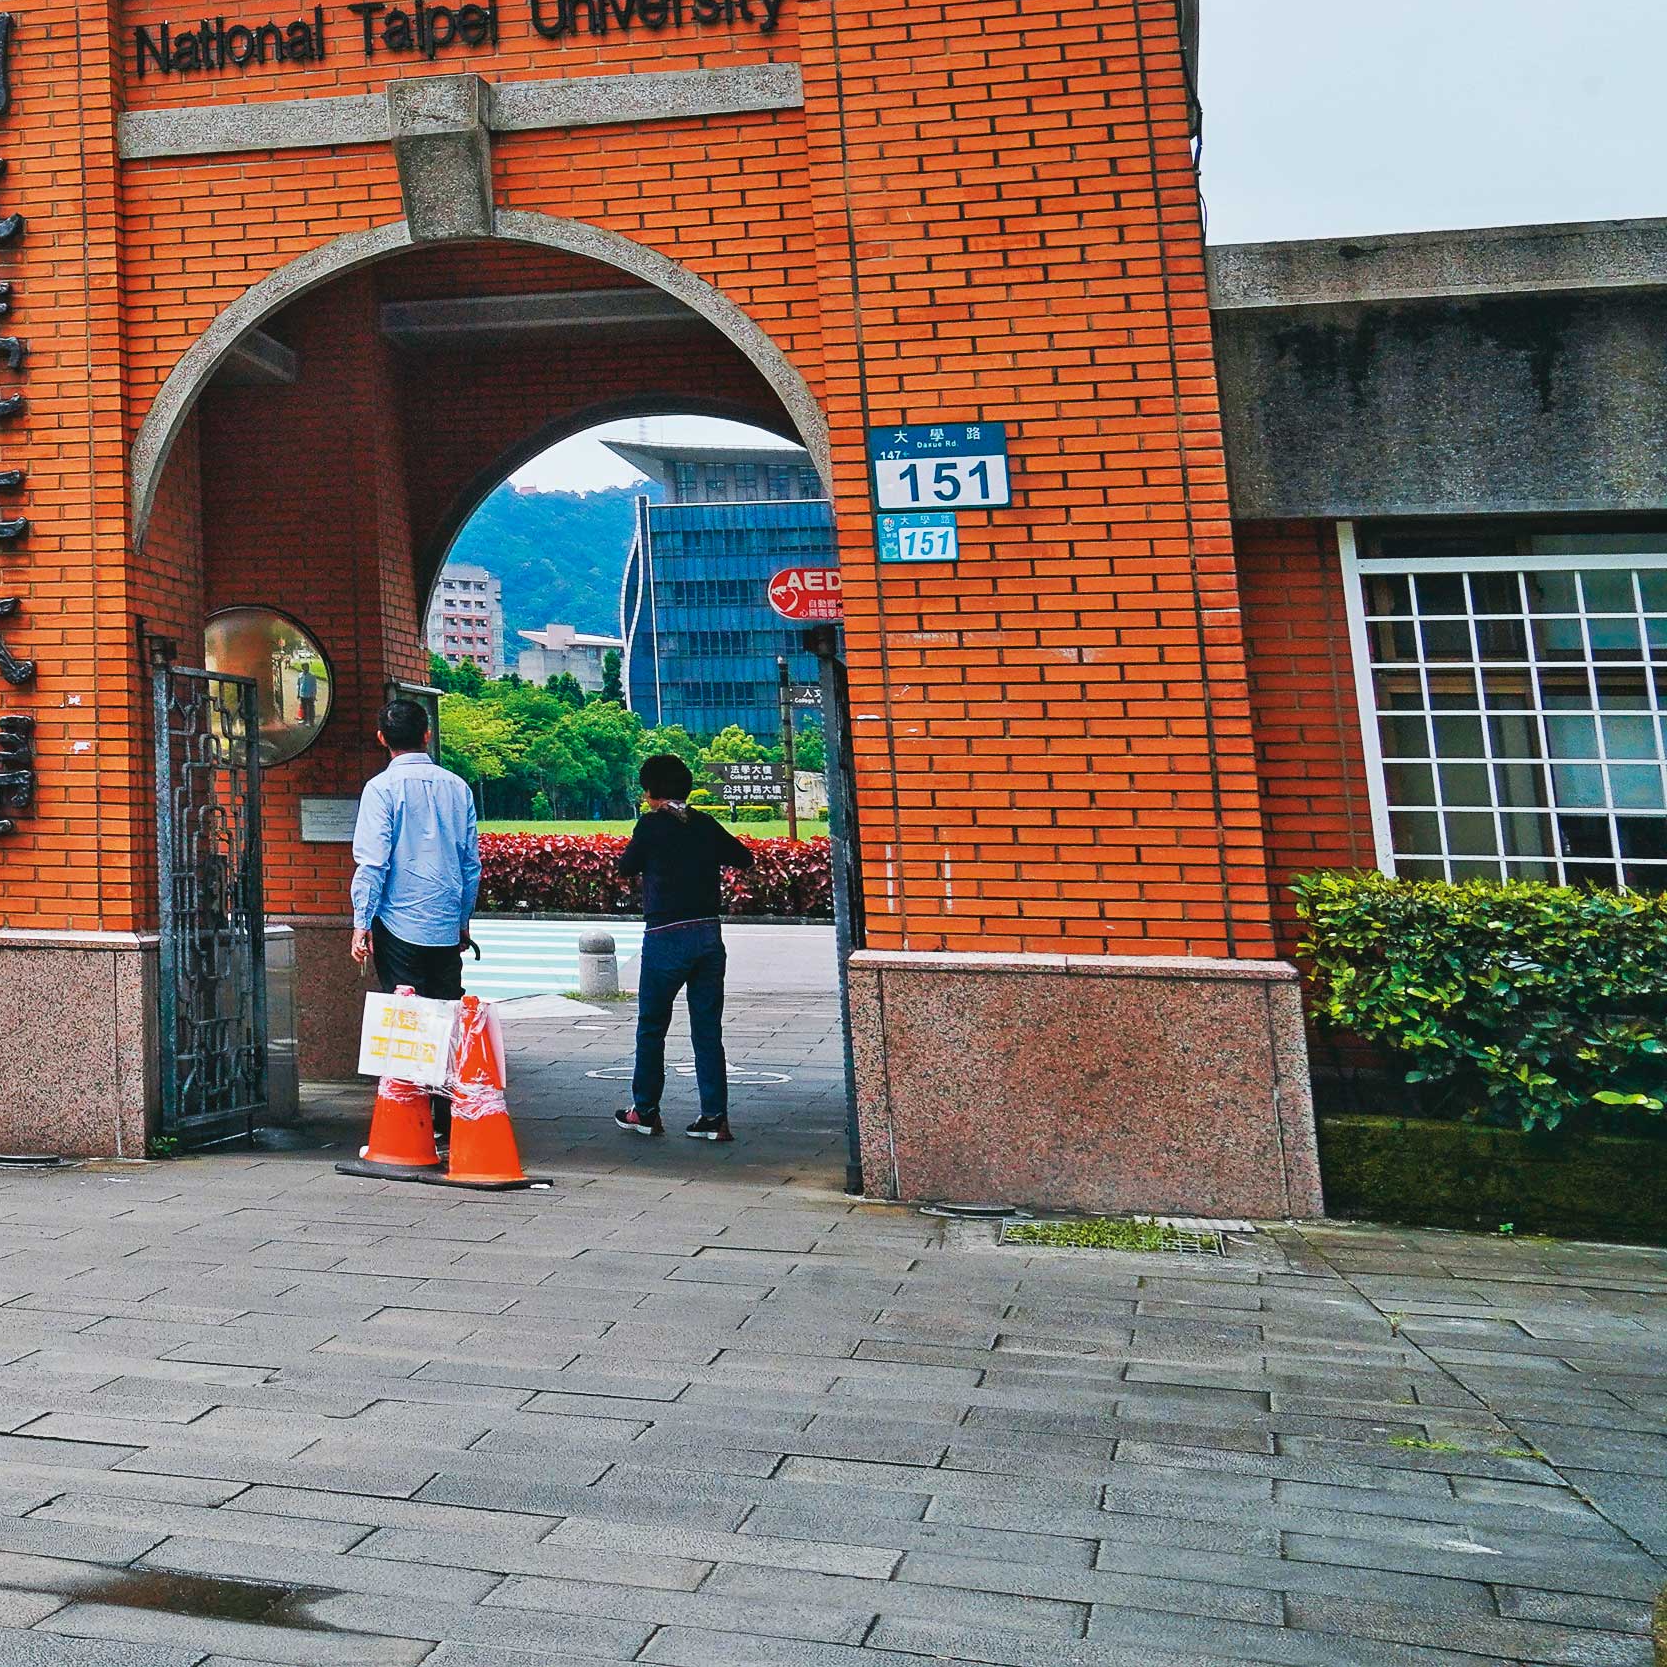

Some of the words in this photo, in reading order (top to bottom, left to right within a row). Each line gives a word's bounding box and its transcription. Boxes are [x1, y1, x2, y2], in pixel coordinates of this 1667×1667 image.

[134, 4, 324, 78] National
[894, 427, 981, 444] 大學路
[916, 441, 942, 449] Daxue
[880, 450, 901, 460] 147
[899, 460, 990, 502] 151
[900, 515, 950, 525] 大學路
[904, 531, 950, 556] 151
[787, 572, 842, 591] AED
[730, 765, 772, 774] 法學大樓
[723, 784, 782, 795] 公共事務大樓
